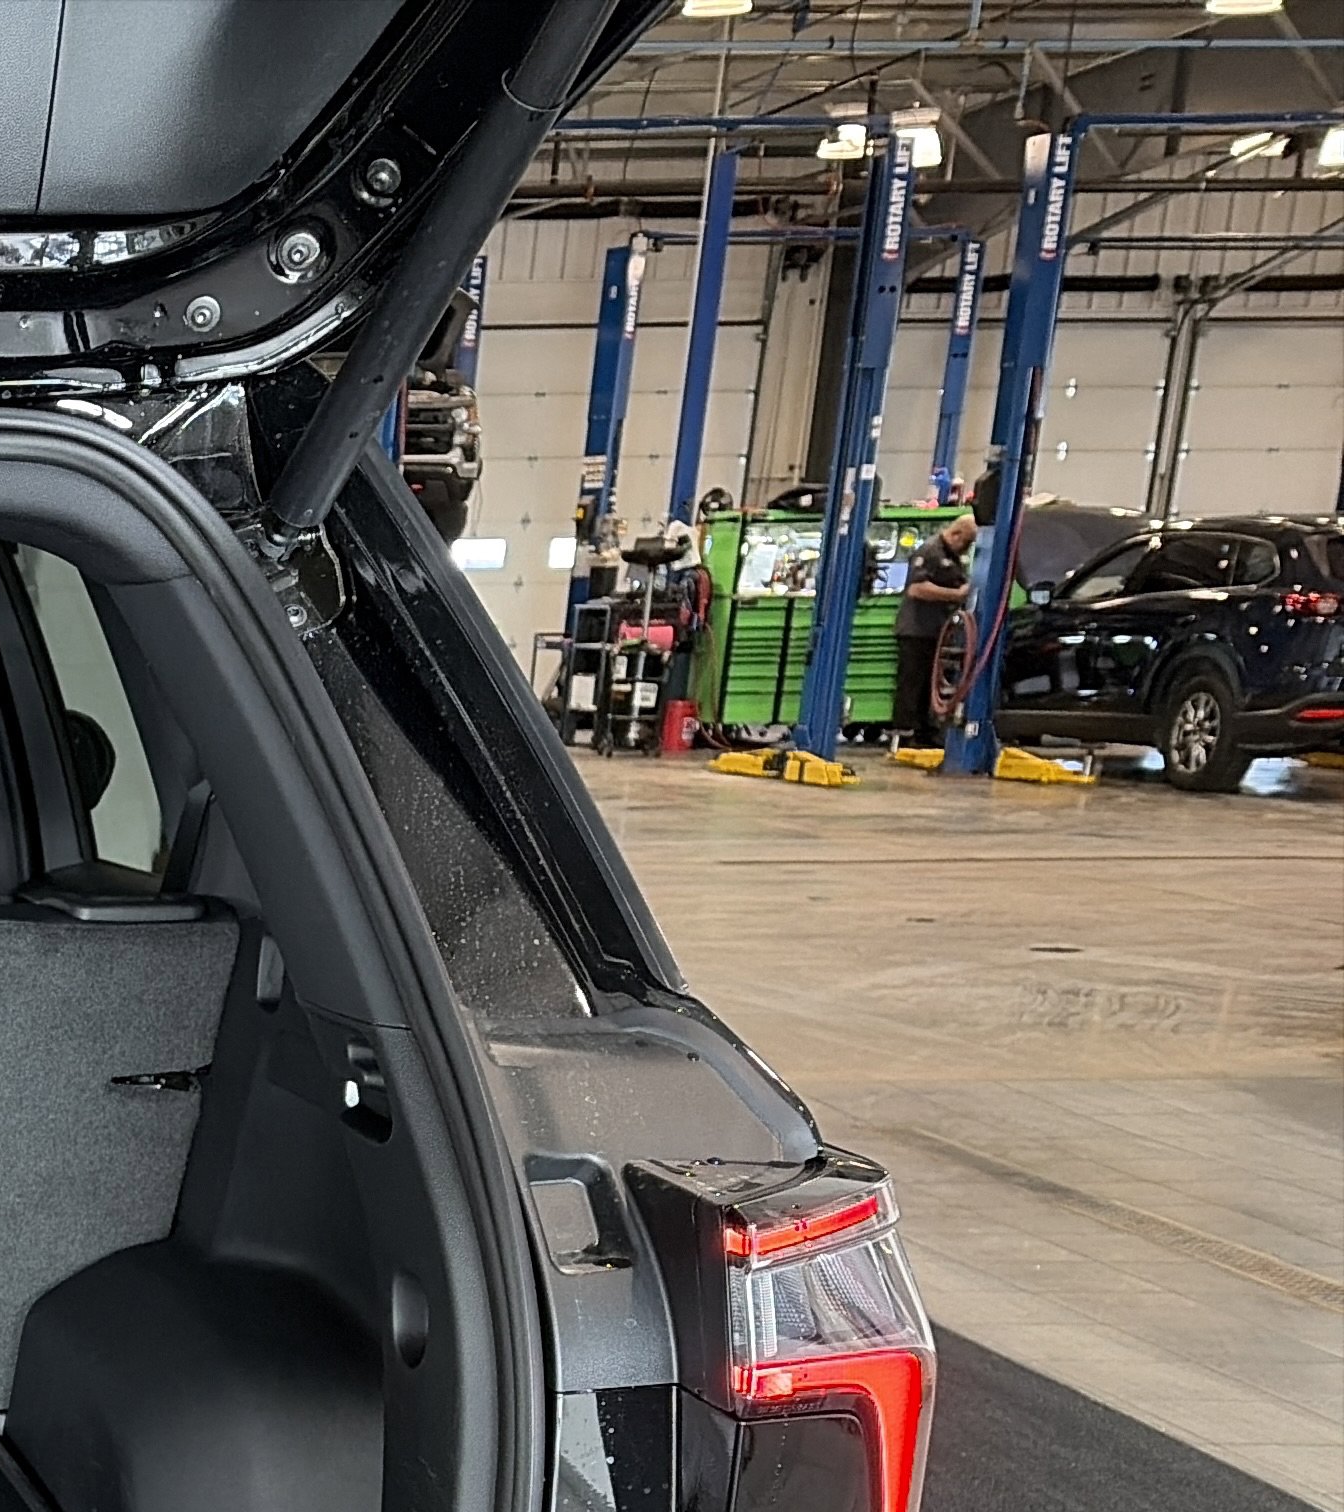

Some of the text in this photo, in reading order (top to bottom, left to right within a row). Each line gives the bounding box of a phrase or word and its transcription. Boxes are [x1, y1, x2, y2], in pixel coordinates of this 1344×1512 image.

[885, 138, 913, 250] ROTARY LIFT
[1042, 134, 1072, 250] ROTARY LIFT
[958, 243, 980, 327] ROTARY LIFT
